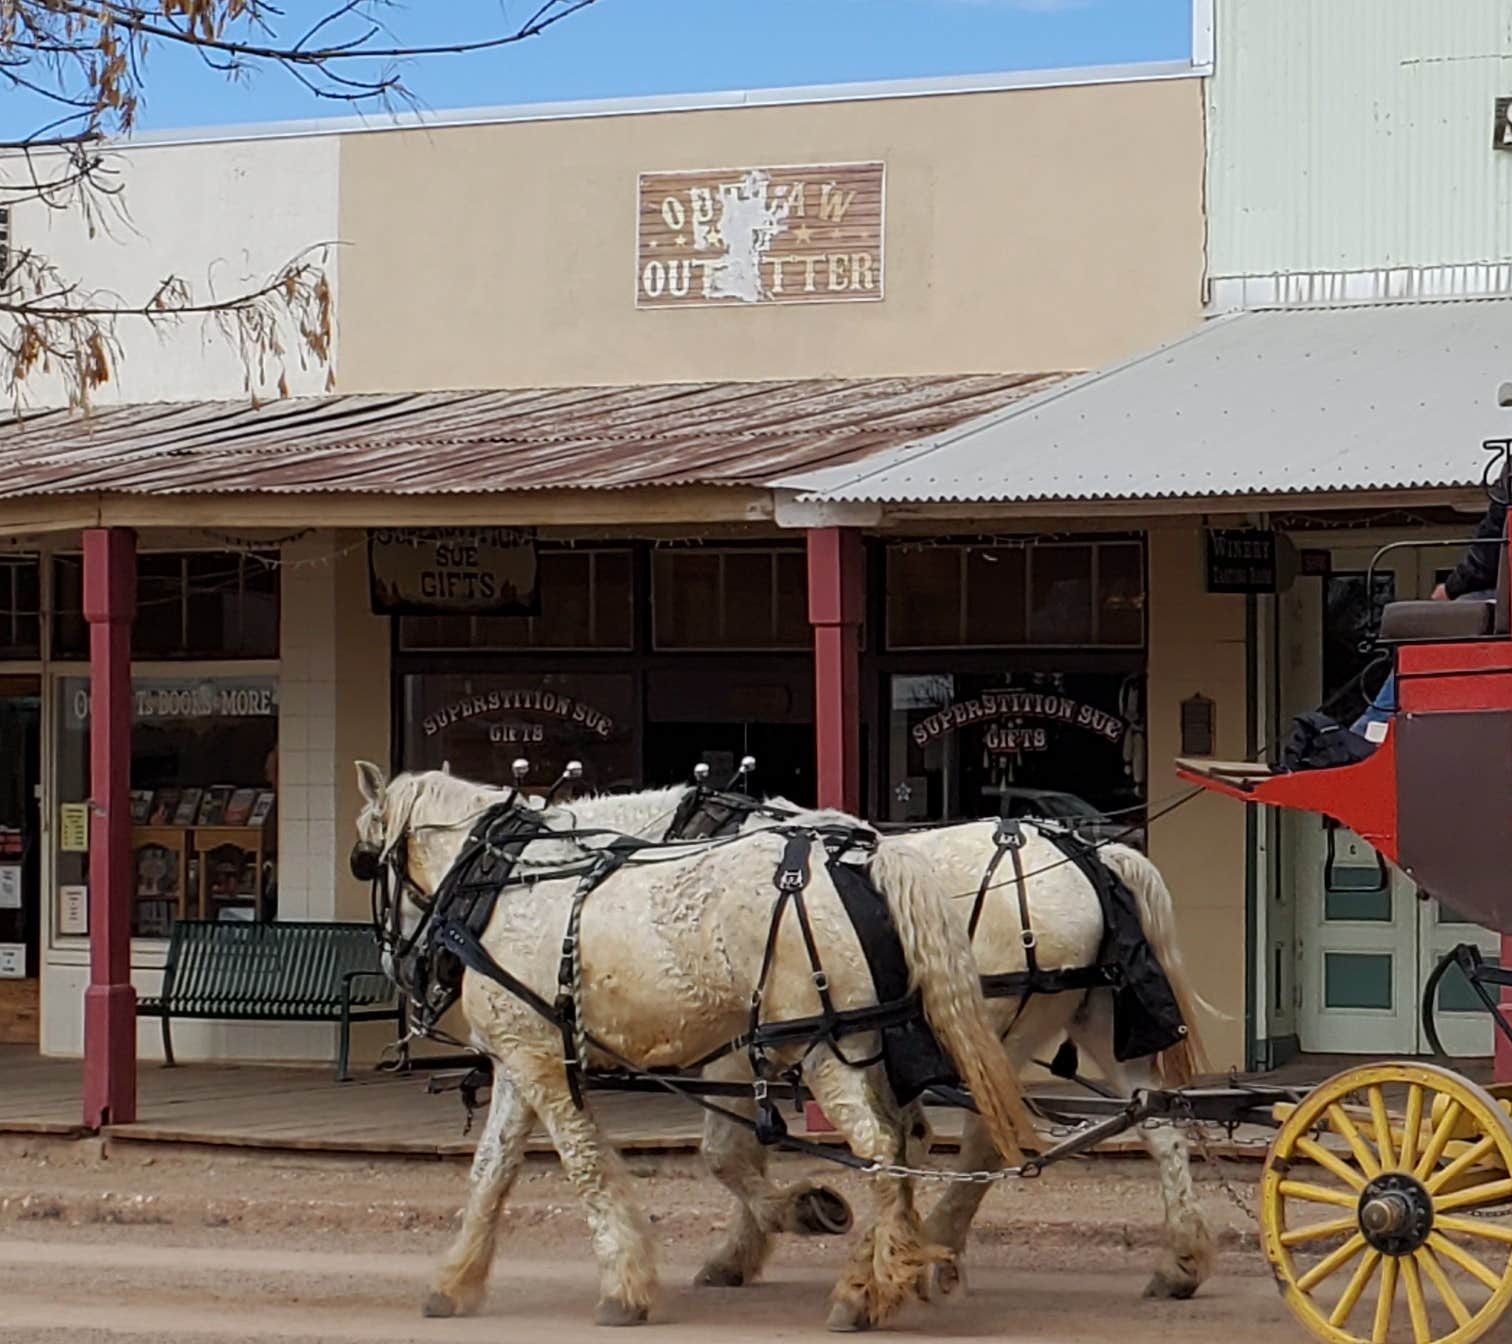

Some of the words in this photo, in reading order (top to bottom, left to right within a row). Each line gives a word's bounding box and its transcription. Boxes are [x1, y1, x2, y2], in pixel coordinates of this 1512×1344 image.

[642, 252, 876, 299] OUTTTER
[435, 544, 478, 567] SUE
[420, 571, 496, 599] GIFTS
[423, 690, 571, 735] SUPERSTITION
[572, 704, 613, 736] SUE
[911, 693, 1075, 745] SUPERSTITION
[1077, 704, 1123, 739] SUE
[986, 728, 1046, 749] GIFTS
